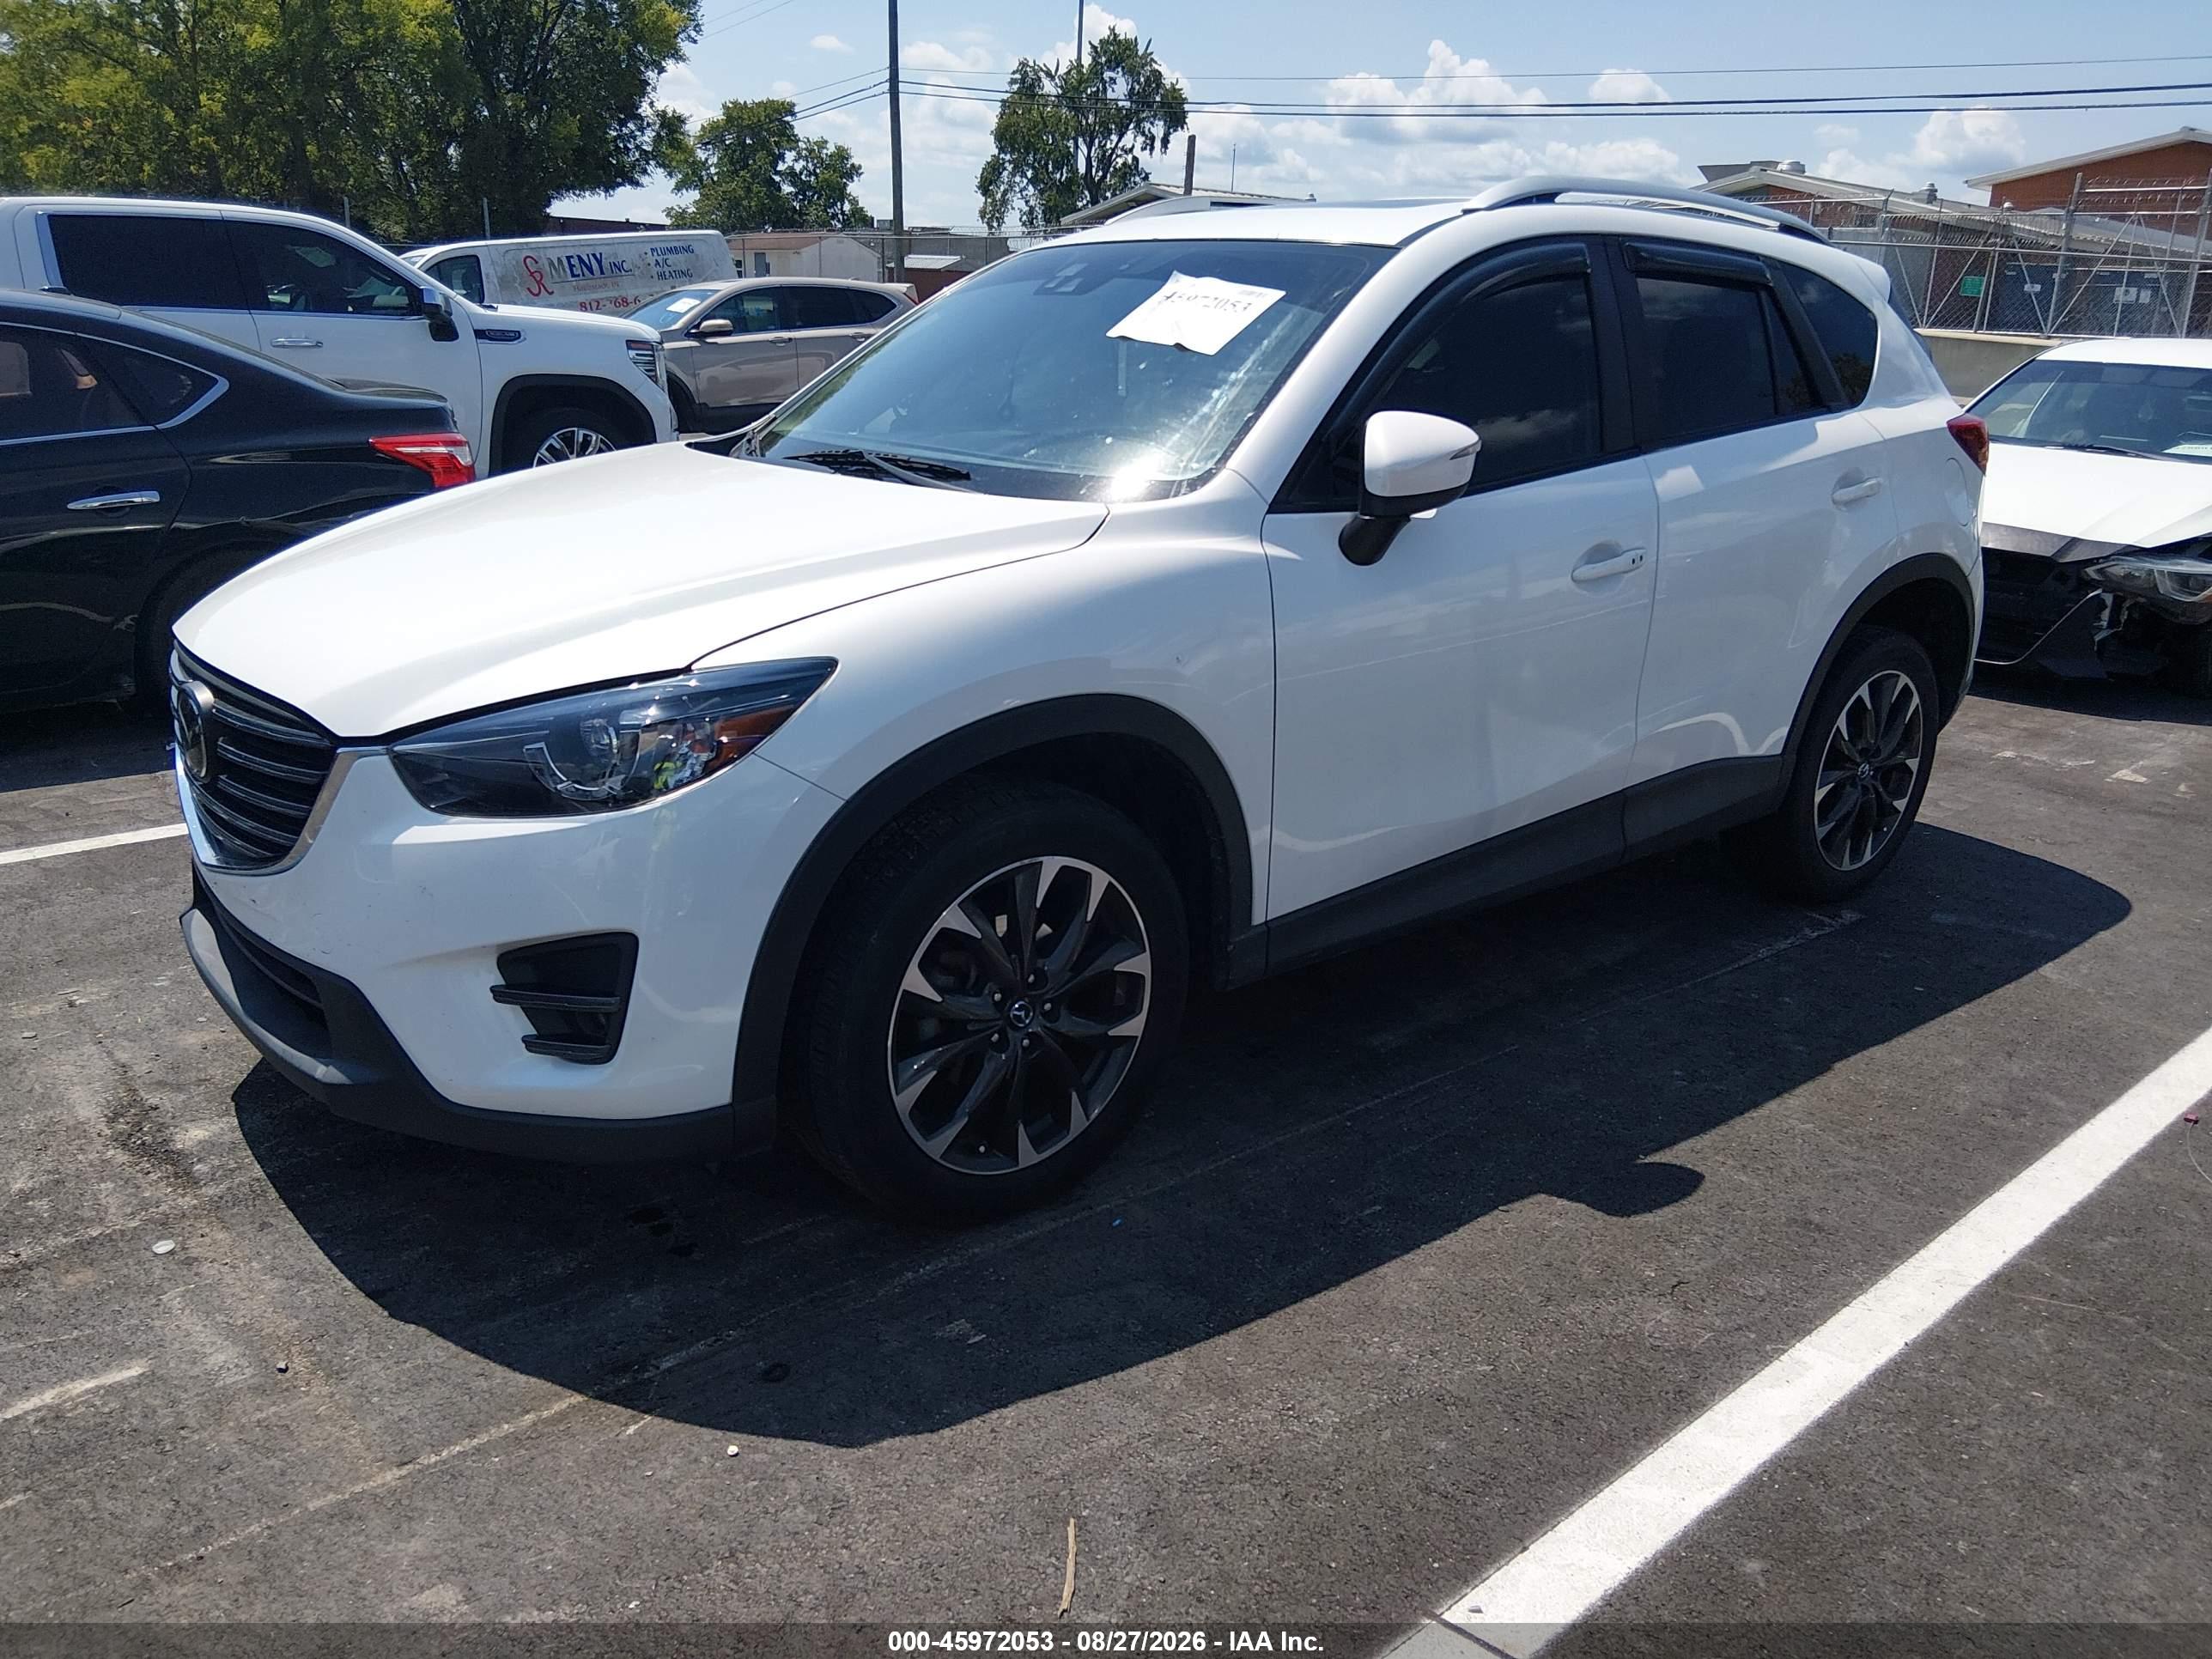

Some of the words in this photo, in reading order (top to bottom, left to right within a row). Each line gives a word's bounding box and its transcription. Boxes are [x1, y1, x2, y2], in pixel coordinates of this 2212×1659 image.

[650, 245, 694, 257] PLUMBING
[609, 260, 632, 274] INC.
[654, 258, 672, 268] A/C
[657, 269, 693, 281] HEATING
